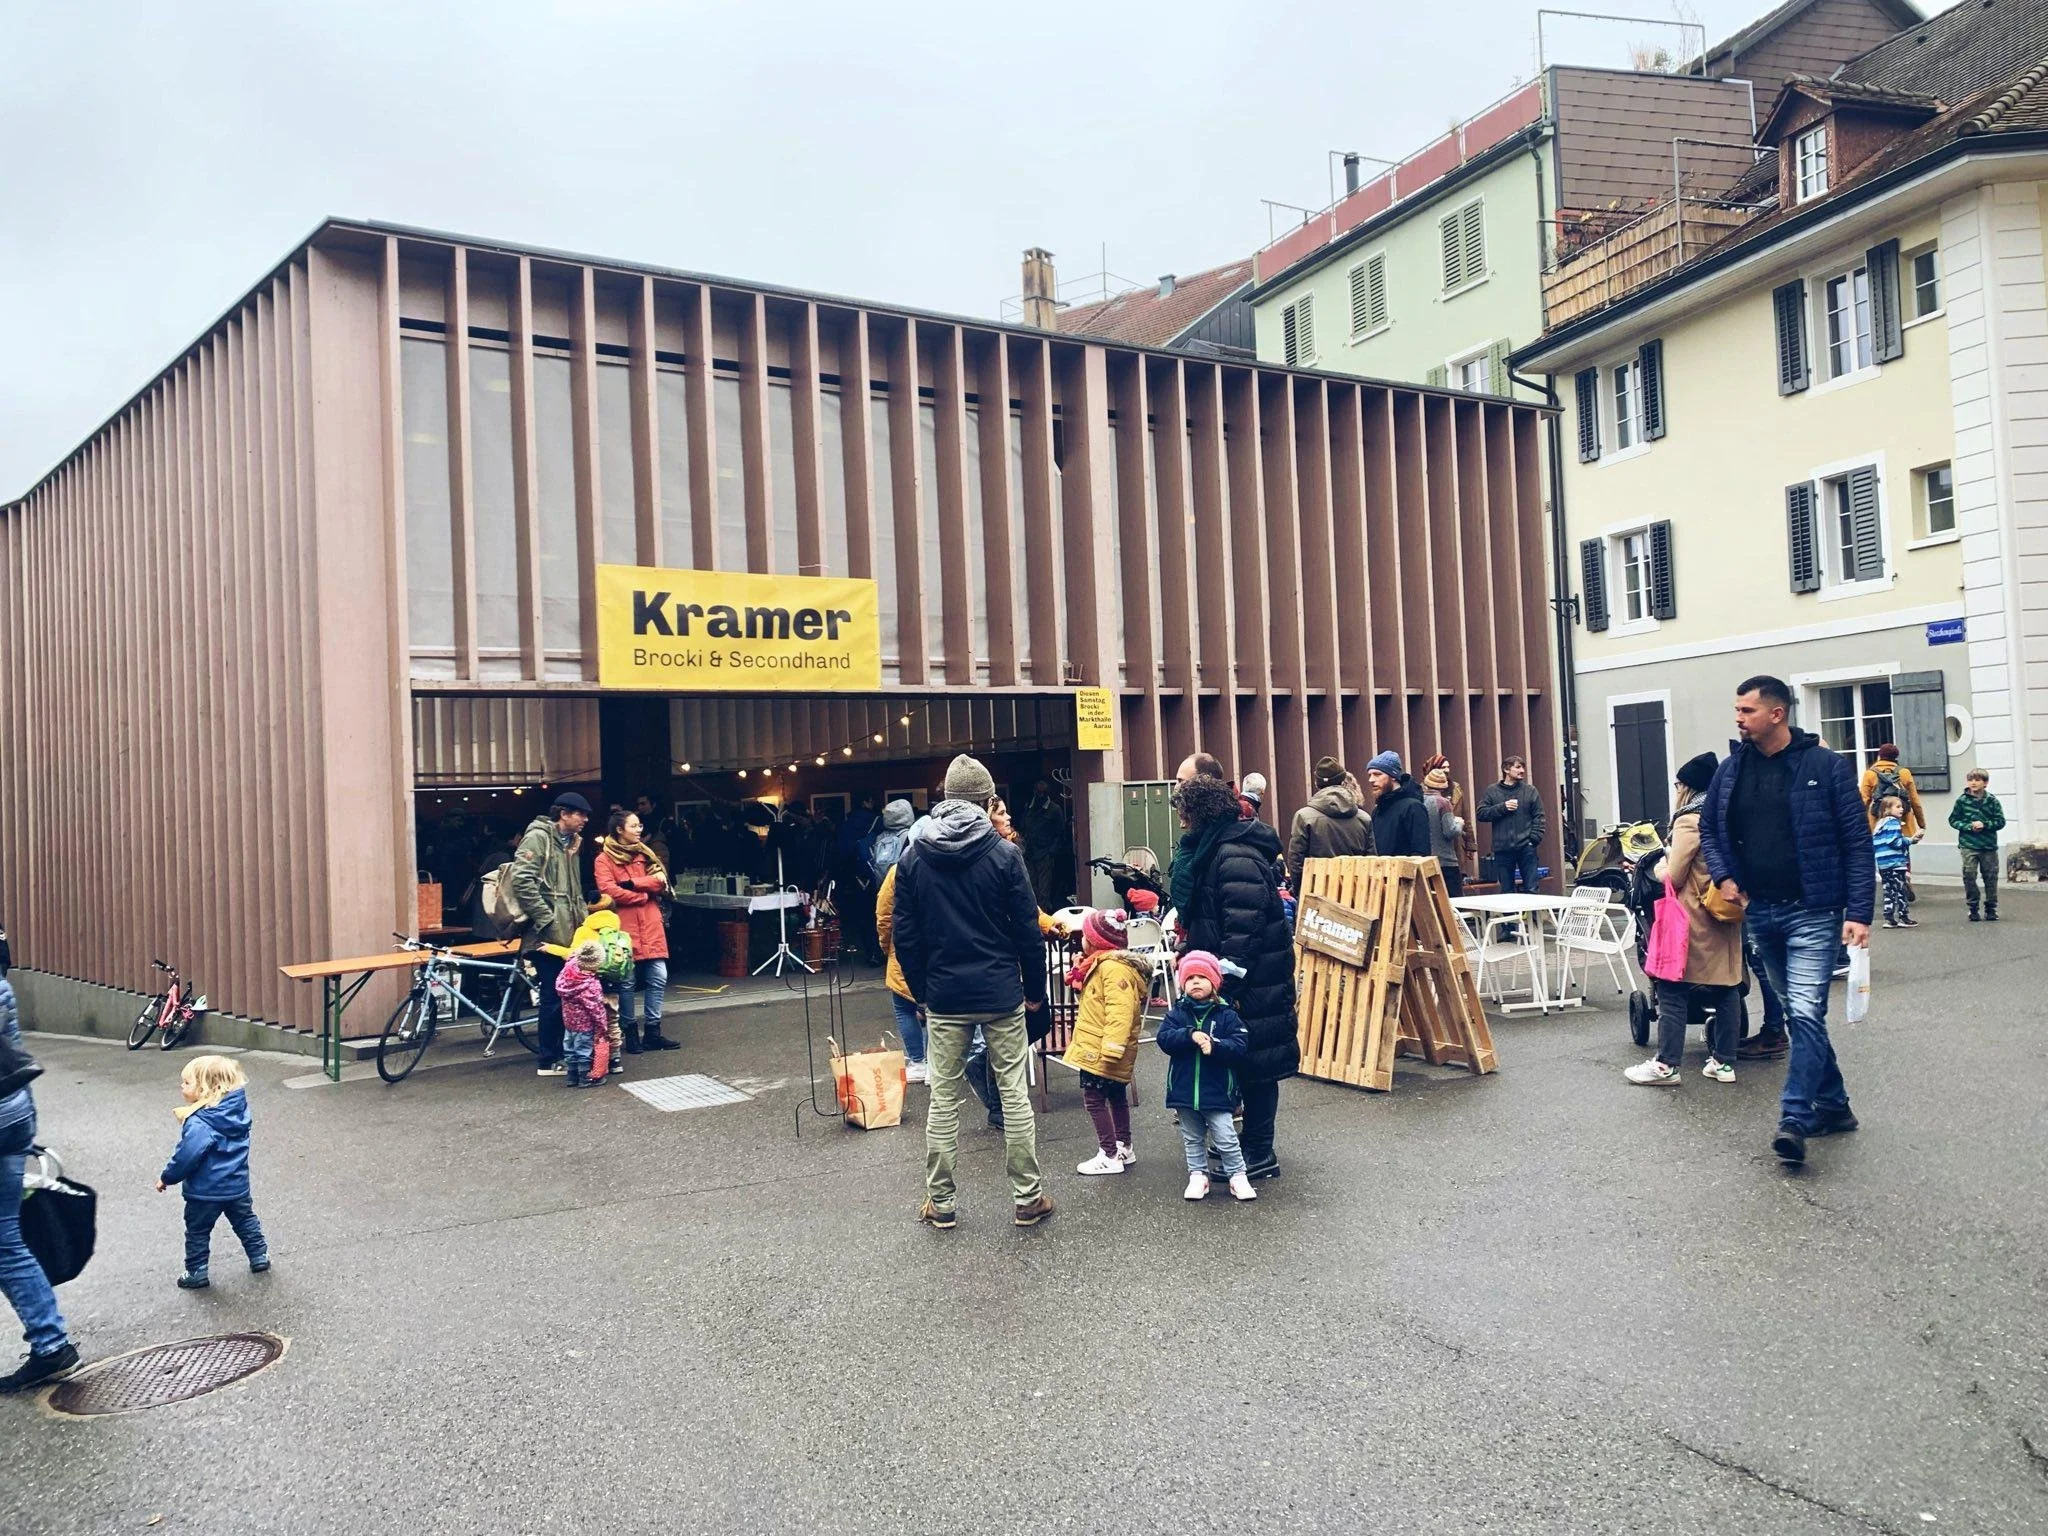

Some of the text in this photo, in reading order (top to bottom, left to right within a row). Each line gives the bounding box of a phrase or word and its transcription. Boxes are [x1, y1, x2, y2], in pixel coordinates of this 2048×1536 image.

[633, 590, 851, 640] Kramer
[634, 649, 850, 669] Brocki & Secondhand
[1304, 907, 1364, 945] Kramer
[873, 1068, 887, 1112] MIGROS
